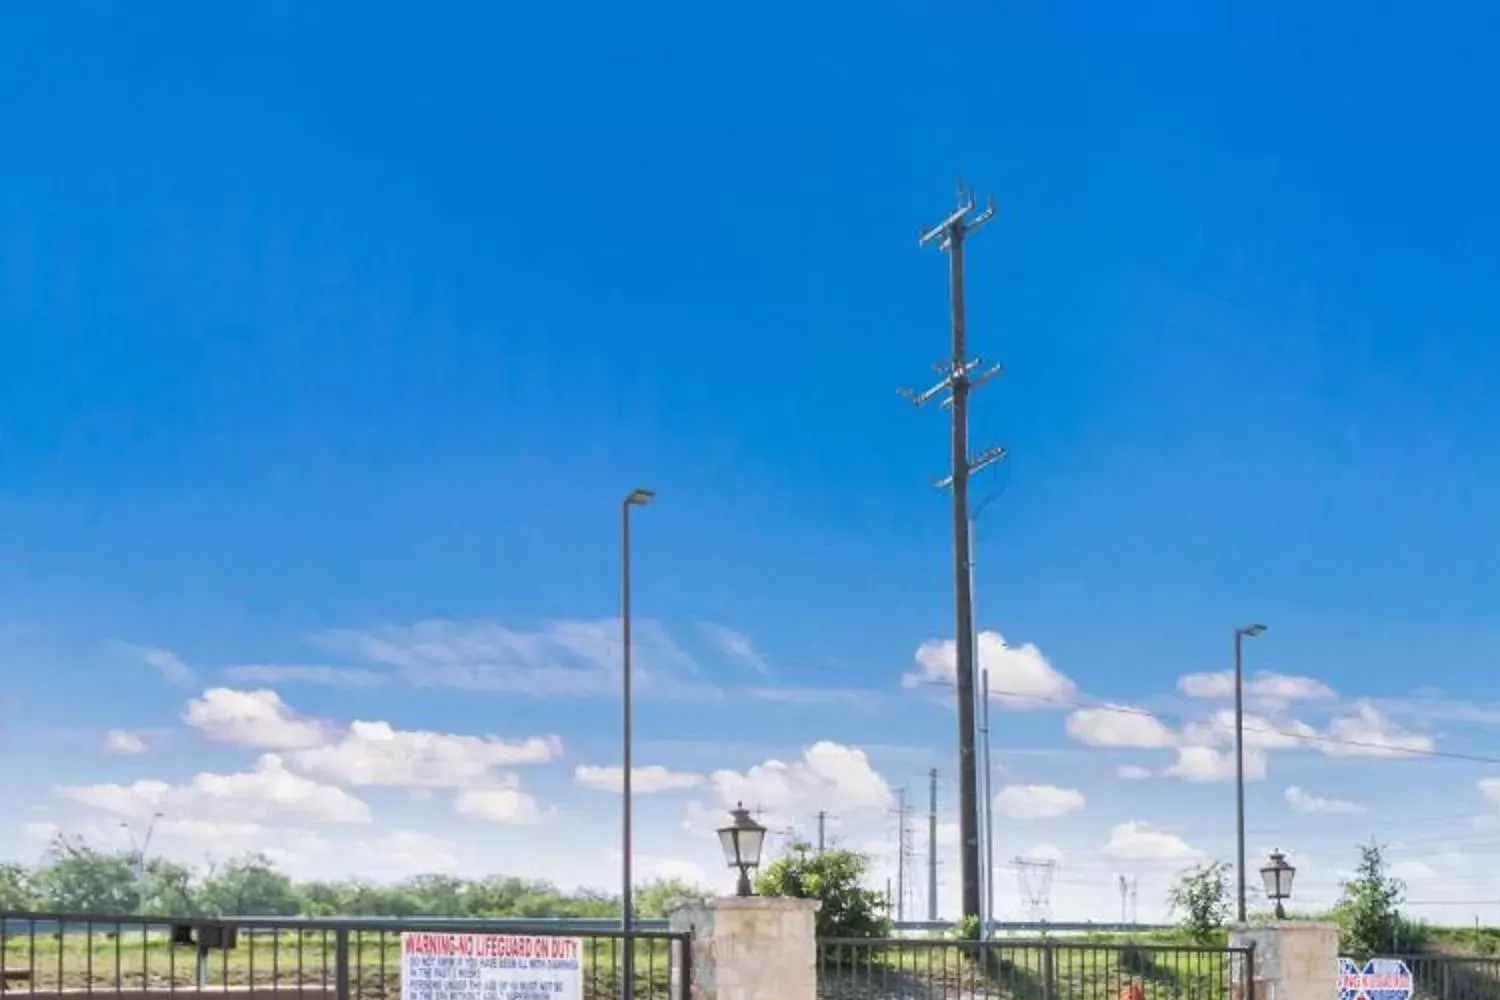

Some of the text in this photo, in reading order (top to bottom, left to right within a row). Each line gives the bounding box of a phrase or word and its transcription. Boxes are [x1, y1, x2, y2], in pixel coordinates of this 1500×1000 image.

[477, 936, 533, 958] LIFEGUARD
[535, 938, 549, 958] ON
[552, 938, 577, 959] DUTY
